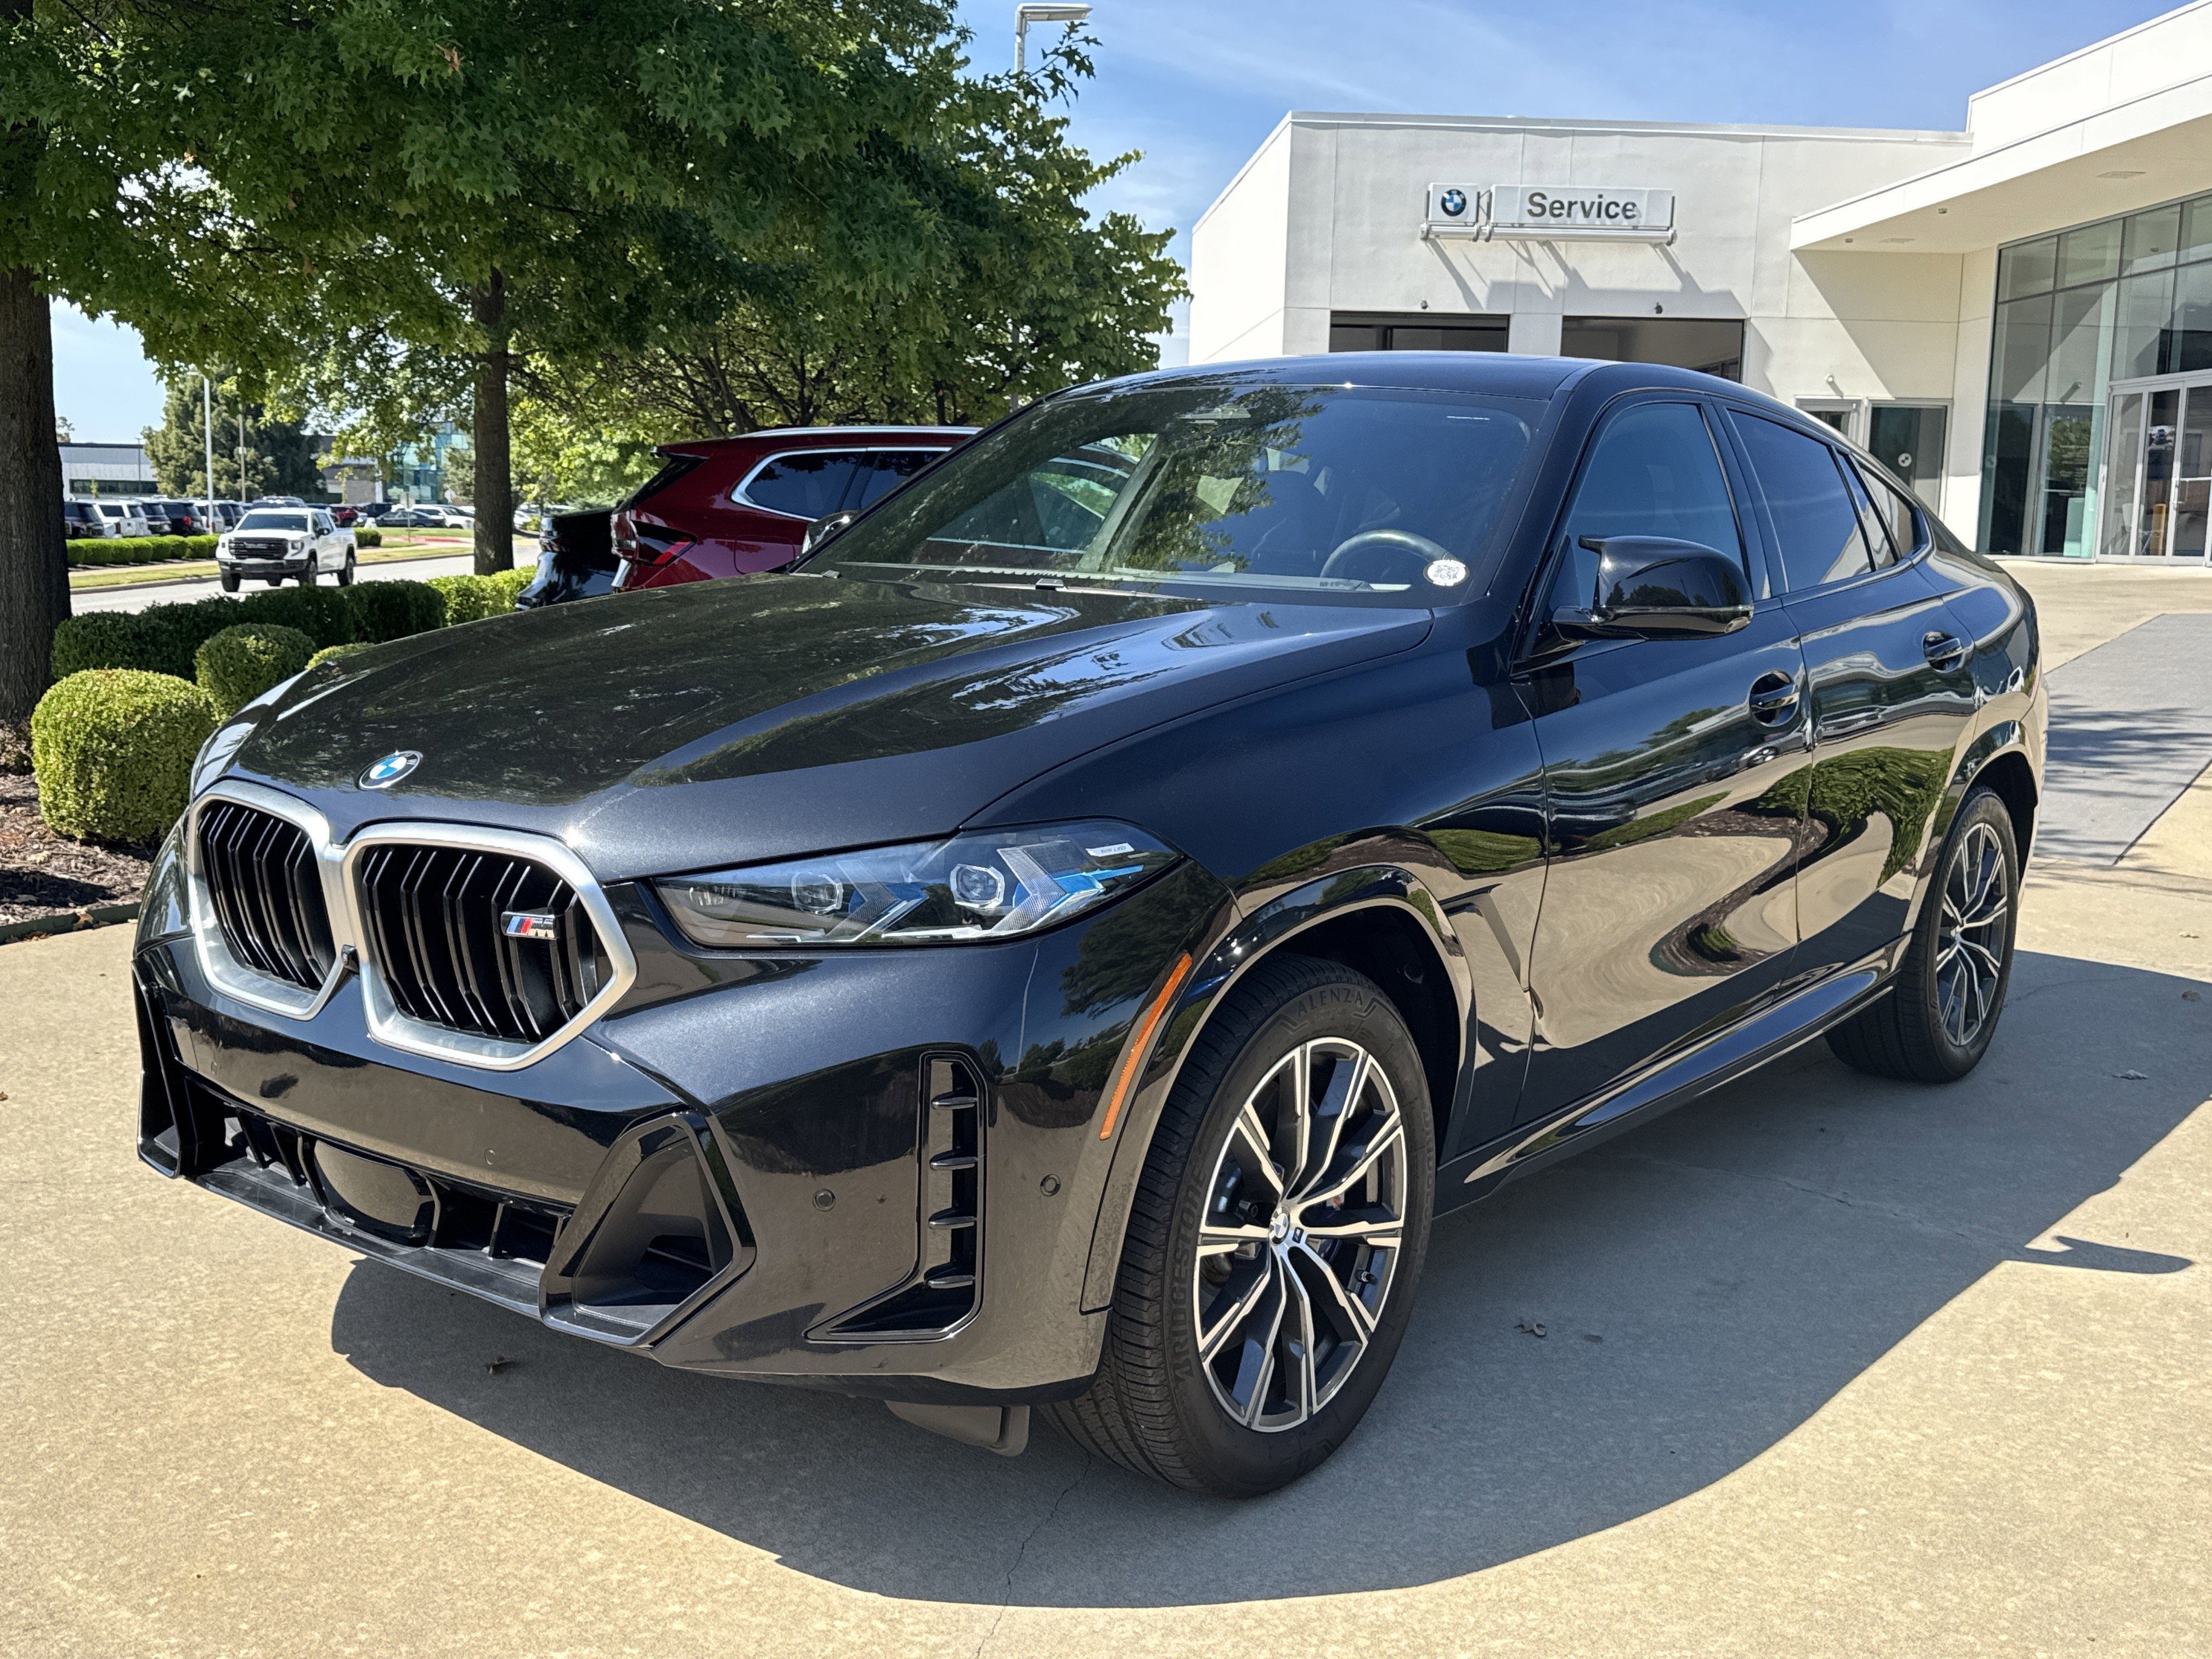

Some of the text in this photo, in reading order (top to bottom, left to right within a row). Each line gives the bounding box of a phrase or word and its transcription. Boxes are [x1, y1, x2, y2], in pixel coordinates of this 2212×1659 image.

[1527, 192, 1638, 219] Service
[1298, 988, 1363, 1018] ALENZA
[1170, 1167, 1206, 1381] BRIDGESTONE
